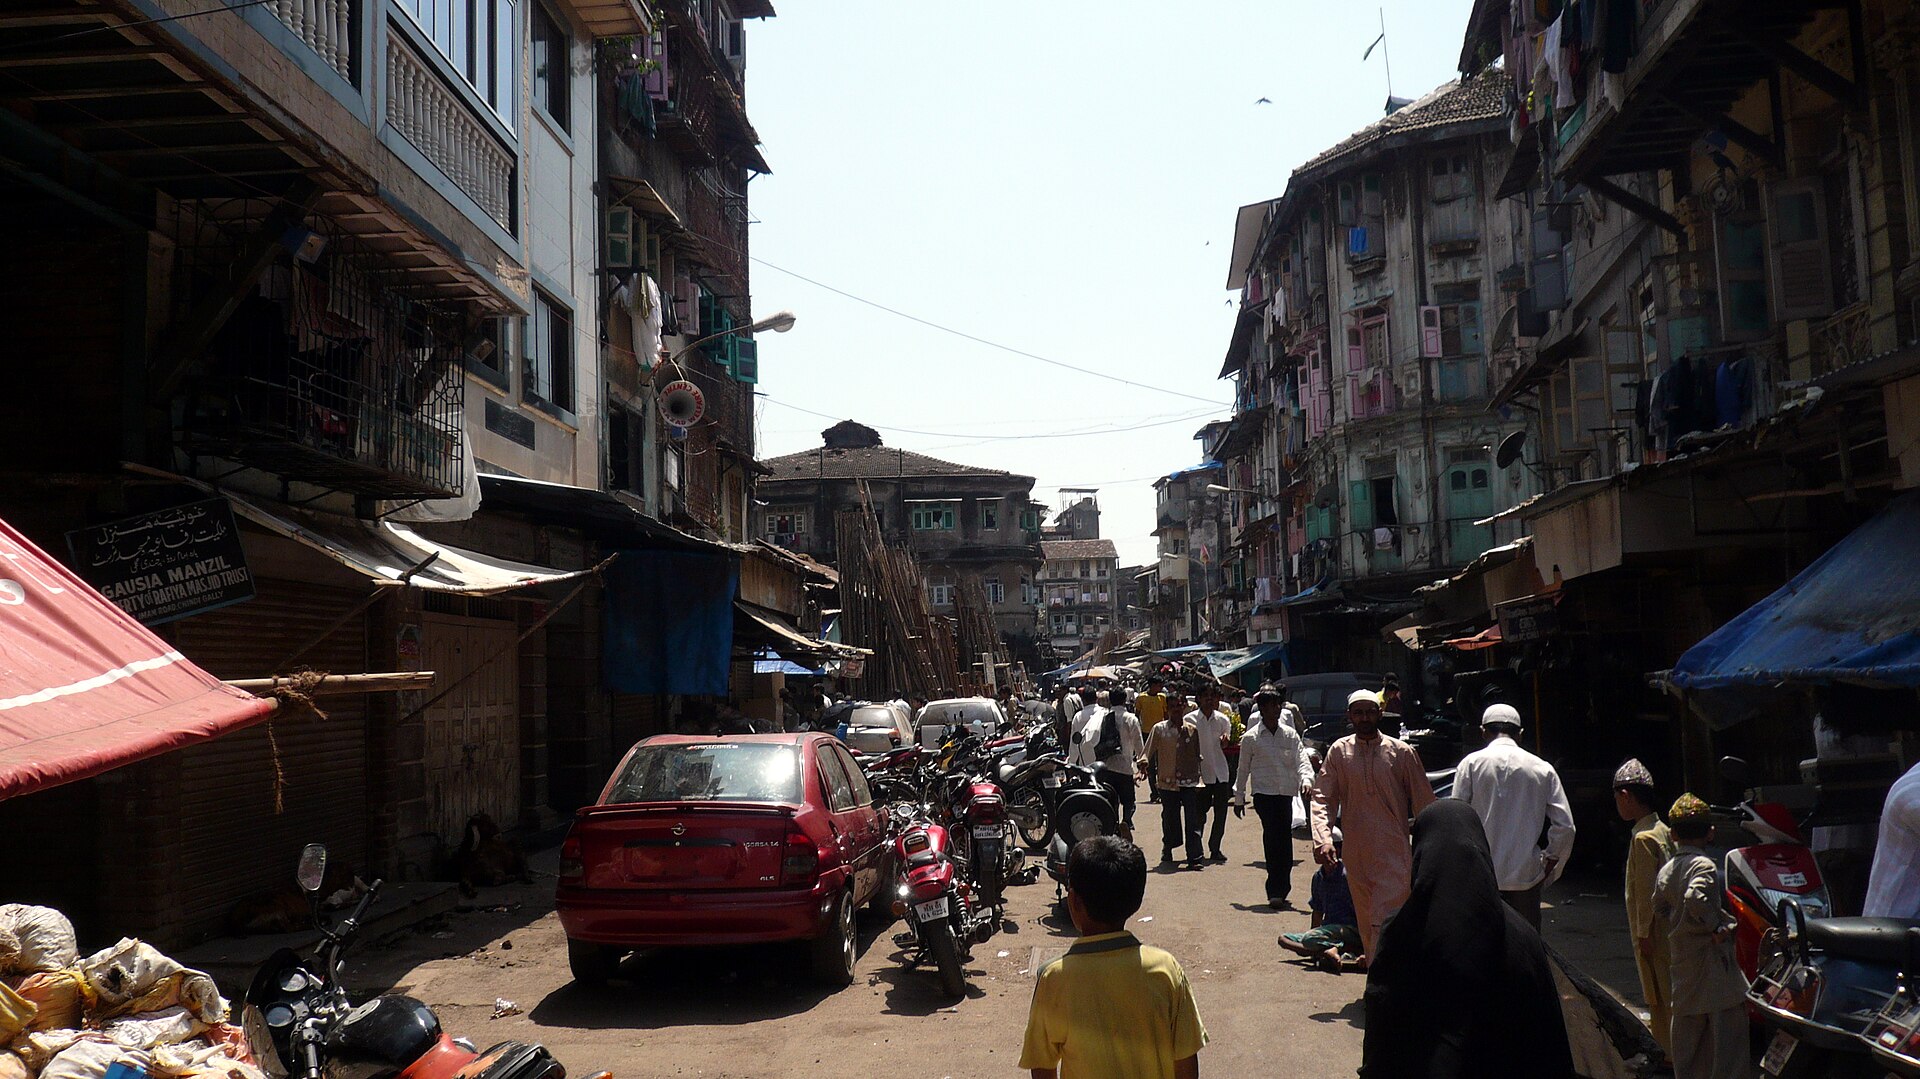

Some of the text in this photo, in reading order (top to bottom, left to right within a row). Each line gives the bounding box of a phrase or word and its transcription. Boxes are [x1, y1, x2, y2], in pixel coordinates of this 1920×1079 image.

[688, 390, 703, 423] WELFARE
[101, 555, 231, 599] GAUSIA MANZIL
[152, 581, 188, 605] RAFIYA
[188, 574, 221, 595] MASJID
[220, 566, 248, 587] TRUST
[202, 591, 224, 603] GALLY
